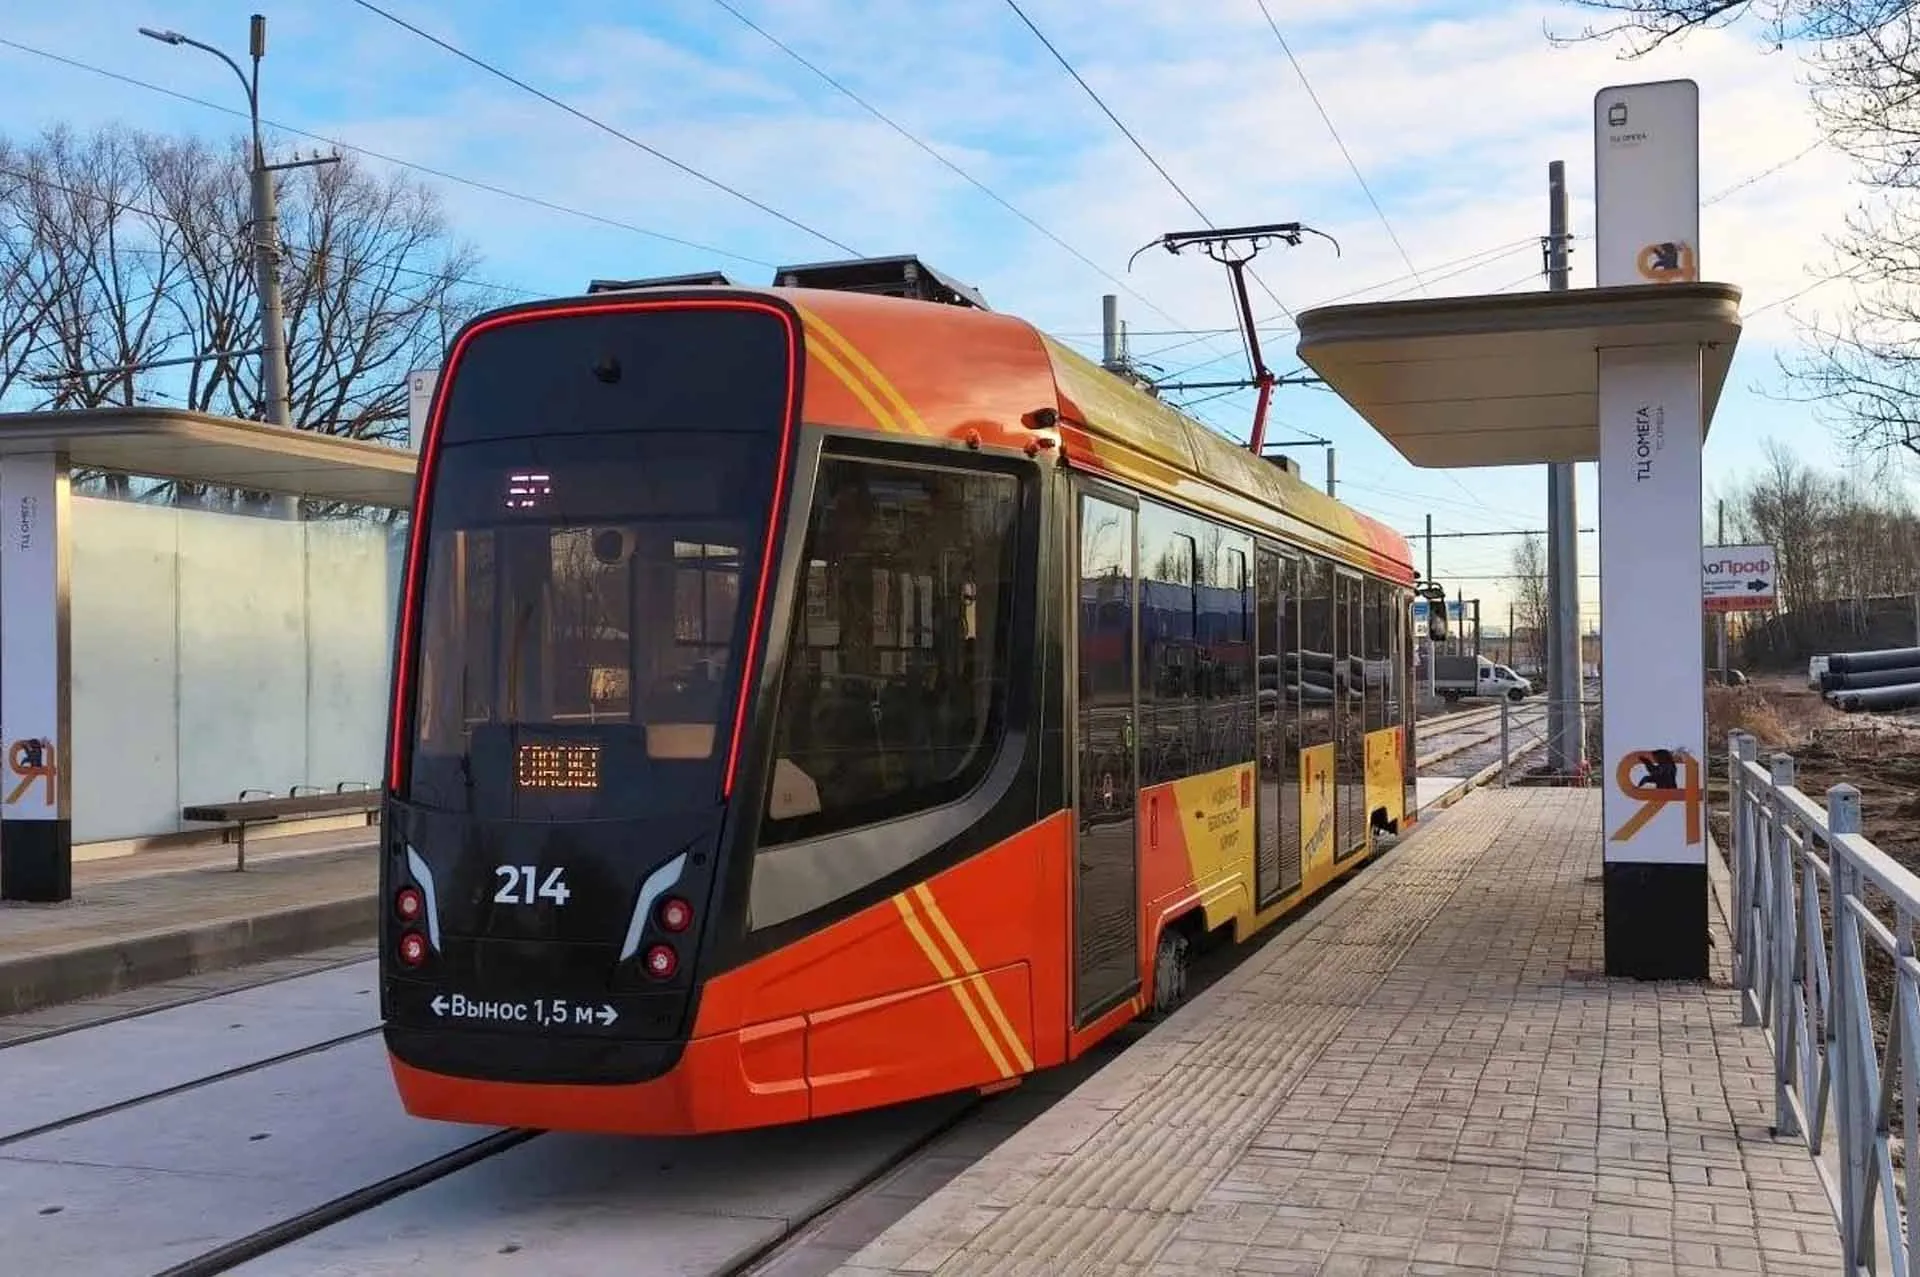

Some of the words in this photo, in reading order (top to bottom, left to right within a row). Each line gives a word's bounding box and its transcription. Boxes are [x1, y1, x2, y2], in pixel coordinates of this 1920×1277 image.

[1636, 406, 1650, 458] ОМЕГА
[1637, 460, 1653, 483] ТЦ
[493, 864, 571, 906] 214
[450, 994, 528, 1021] Вынос
[534, 998, 567, 1026] 1,5
[575, 1010, 593, 1025] м
